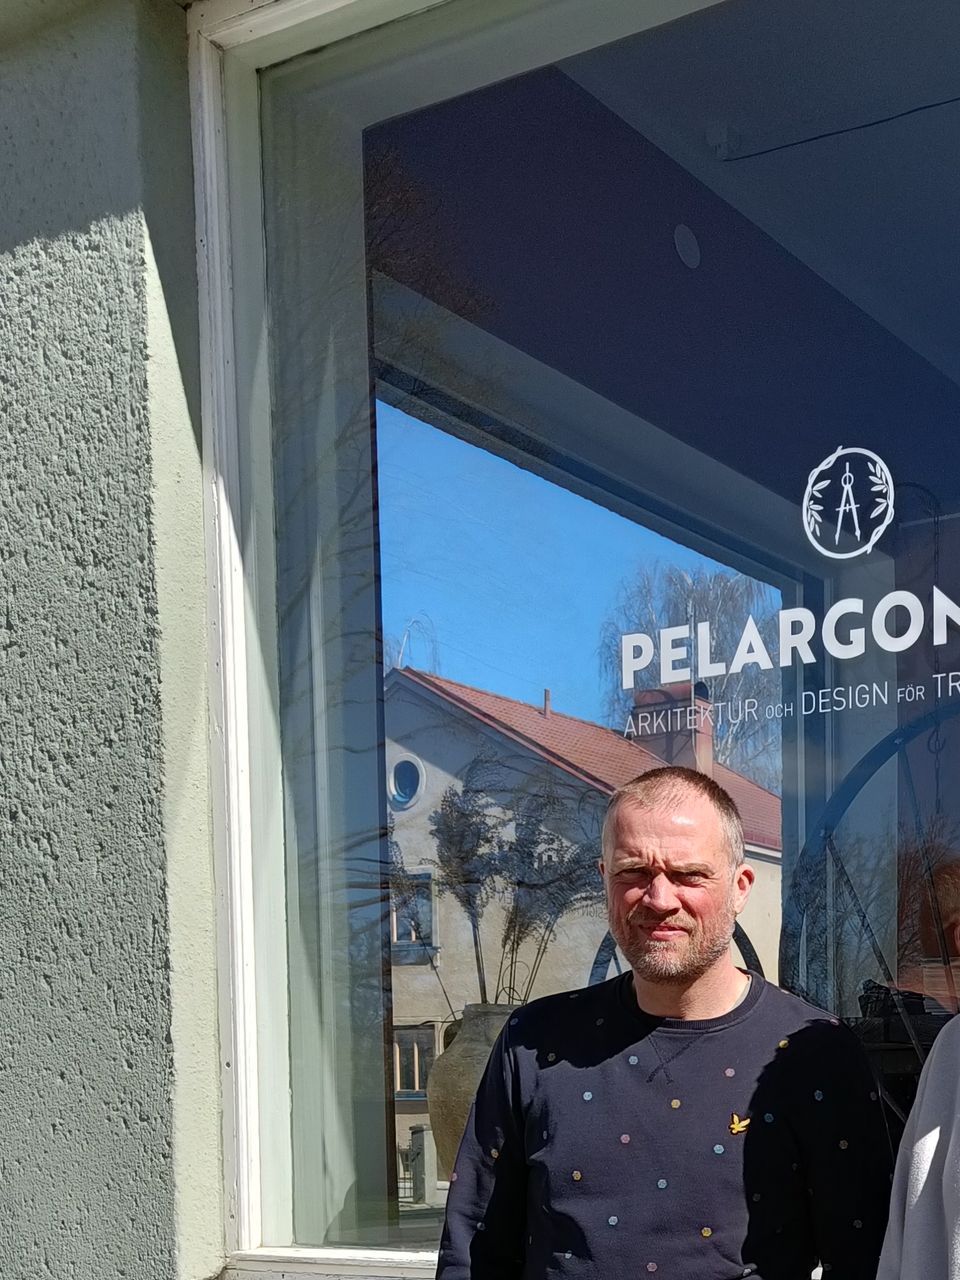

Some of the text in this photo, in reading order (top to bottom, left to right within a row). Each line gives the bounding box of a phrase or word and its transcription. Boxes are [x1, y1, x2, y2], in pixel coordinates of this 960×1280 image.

[624, 698, 758, 737] ARKITEKTUR
[765, 702, 794, 719] OCH
[801, 681, 888, 715] DESIGN
[897, 684, 925, 703] FÖR
